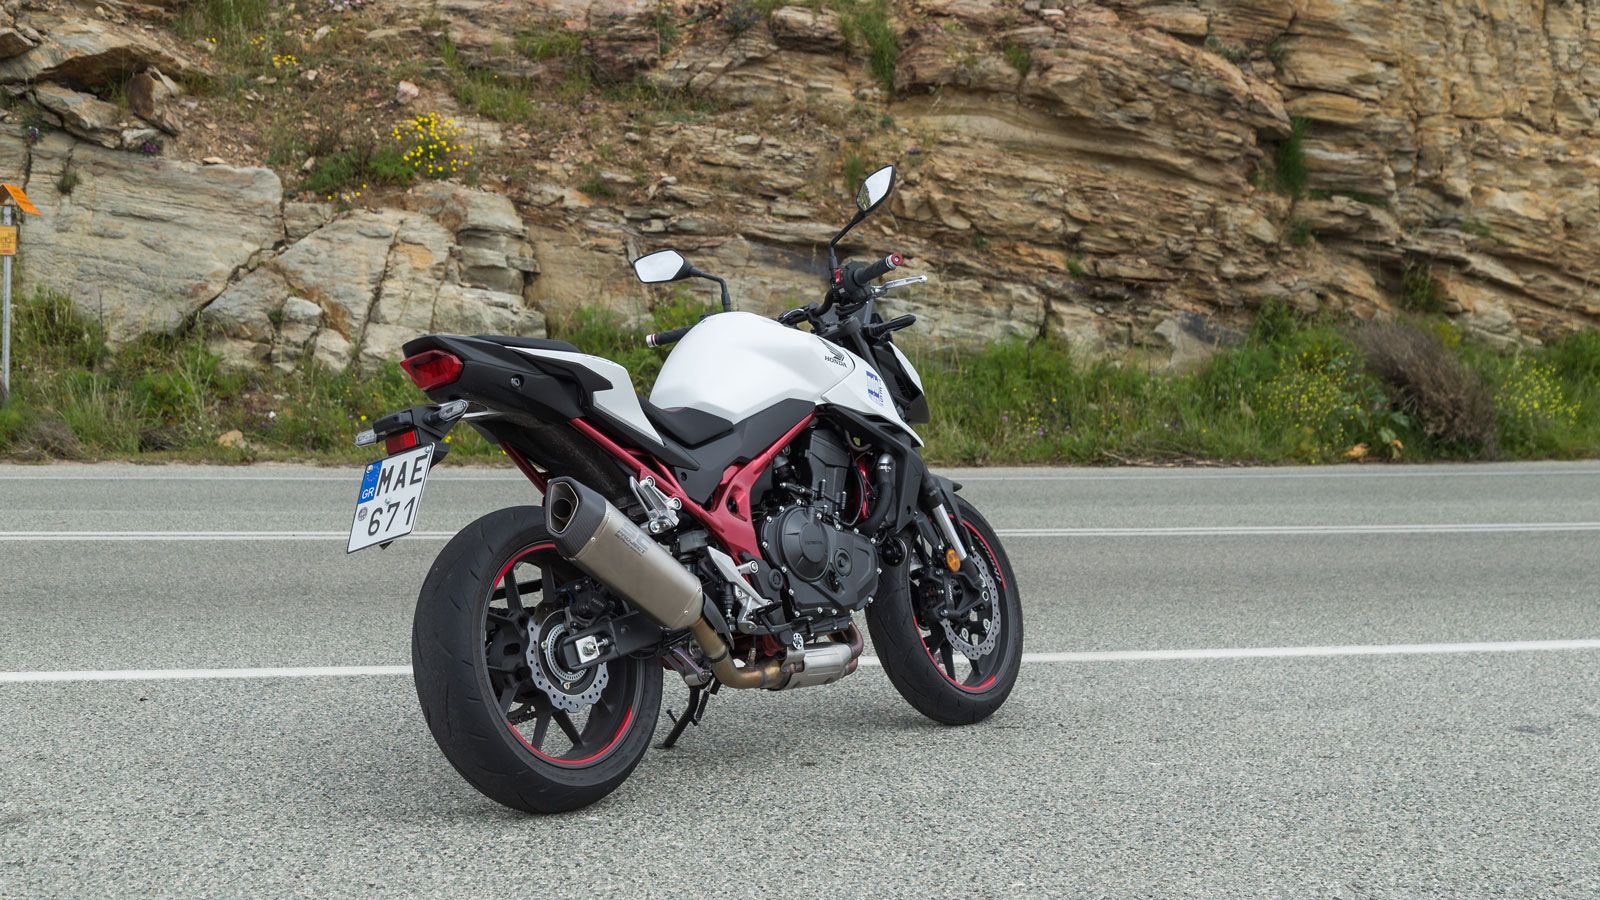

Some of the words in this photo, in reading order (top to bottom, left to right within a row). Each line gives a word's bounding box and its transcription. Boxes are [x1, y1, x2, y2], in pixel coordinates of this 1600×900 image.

[824, 355, 848, 369] HONDA
[376, 453, 429, 497] MAE
[361, 486, 375, 500] GR
[367, 496, 416, 537] 671
